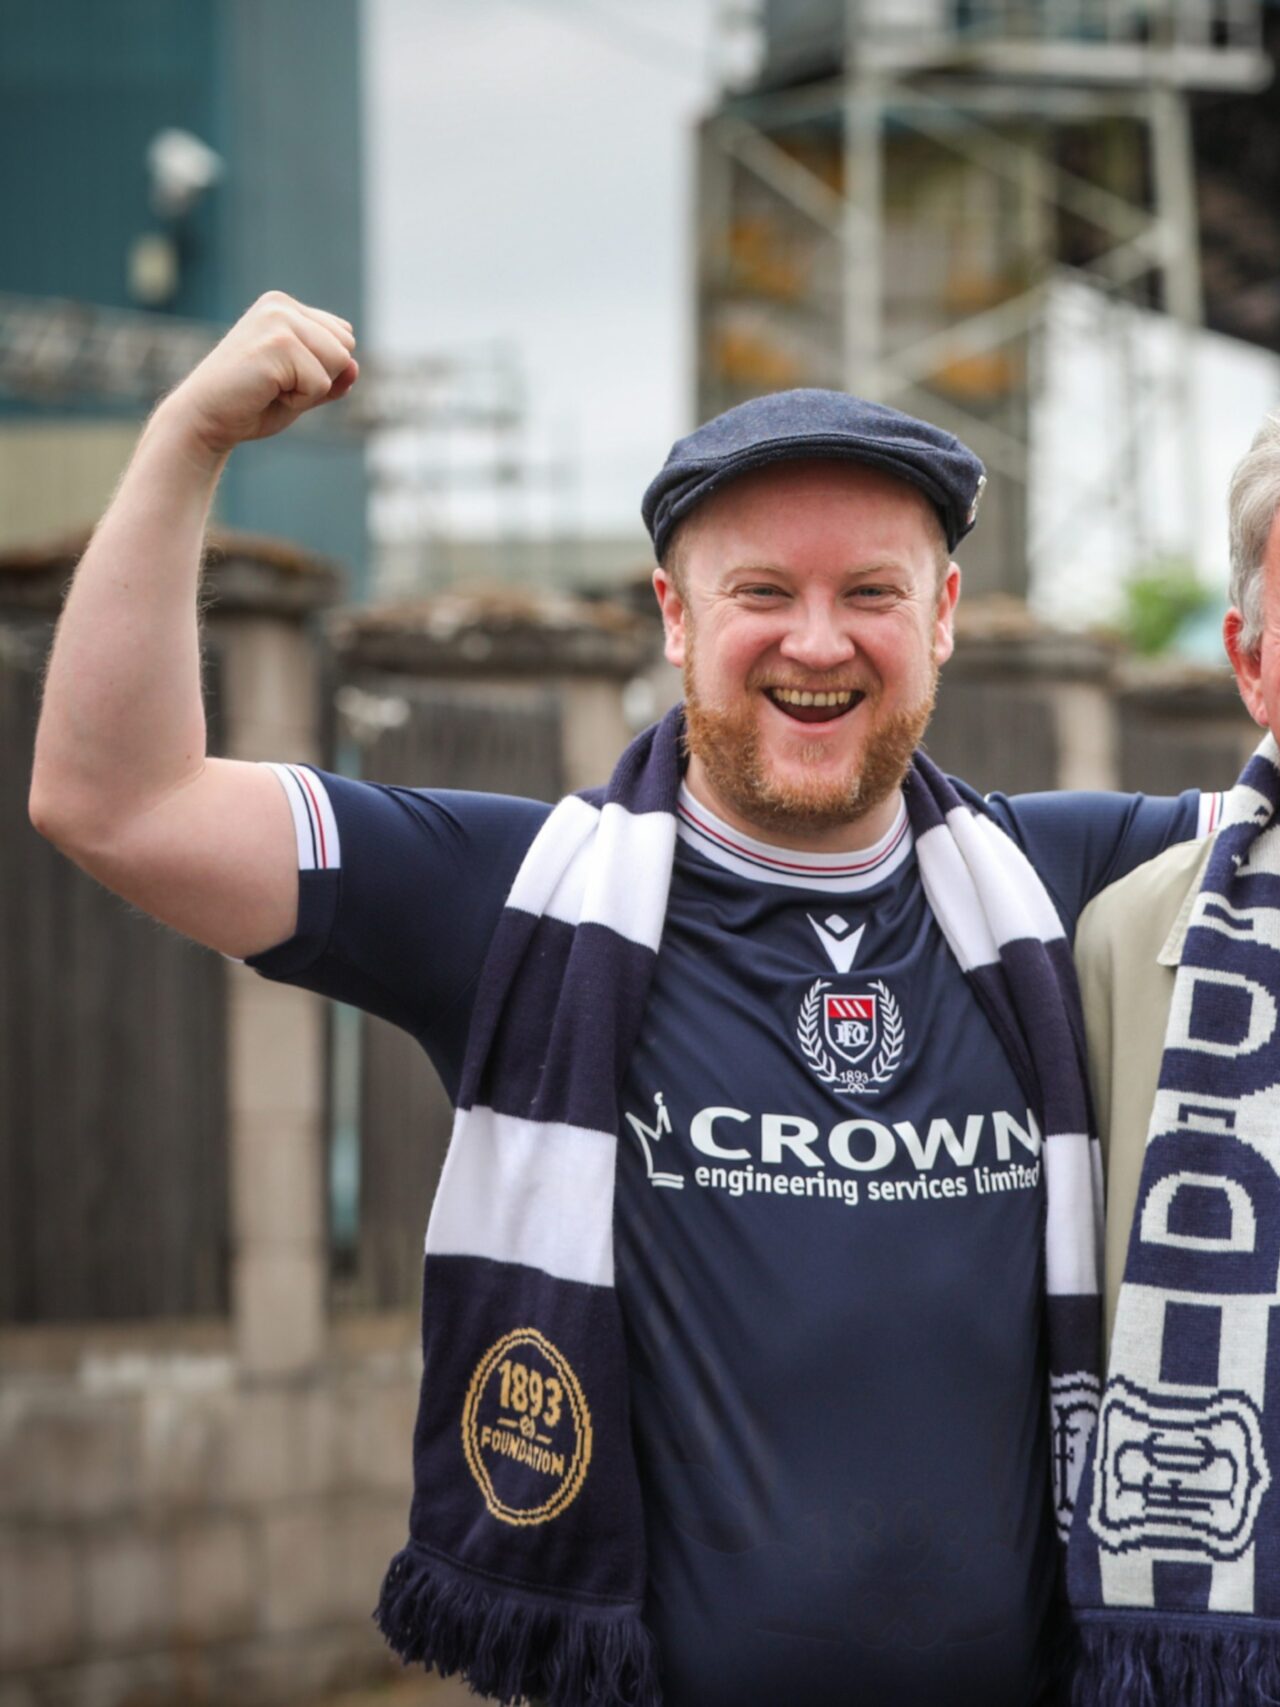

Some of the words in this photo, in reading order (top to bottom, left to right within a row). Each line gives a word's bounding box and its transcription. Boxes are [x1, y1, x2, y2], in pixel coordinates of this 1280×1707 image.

[840, 1070, 869, 1085] 1893
[689, 1107, 1041, 1171] CROWN
[695, 1165, 859, 1206] engineering
[867, 1173, 968, 1202] services
[973, 1160, 1040, 1194] limited
[498, 1359, 564, 1428] 1893
[480, 1425, 566, 1477] FOUNDATION
